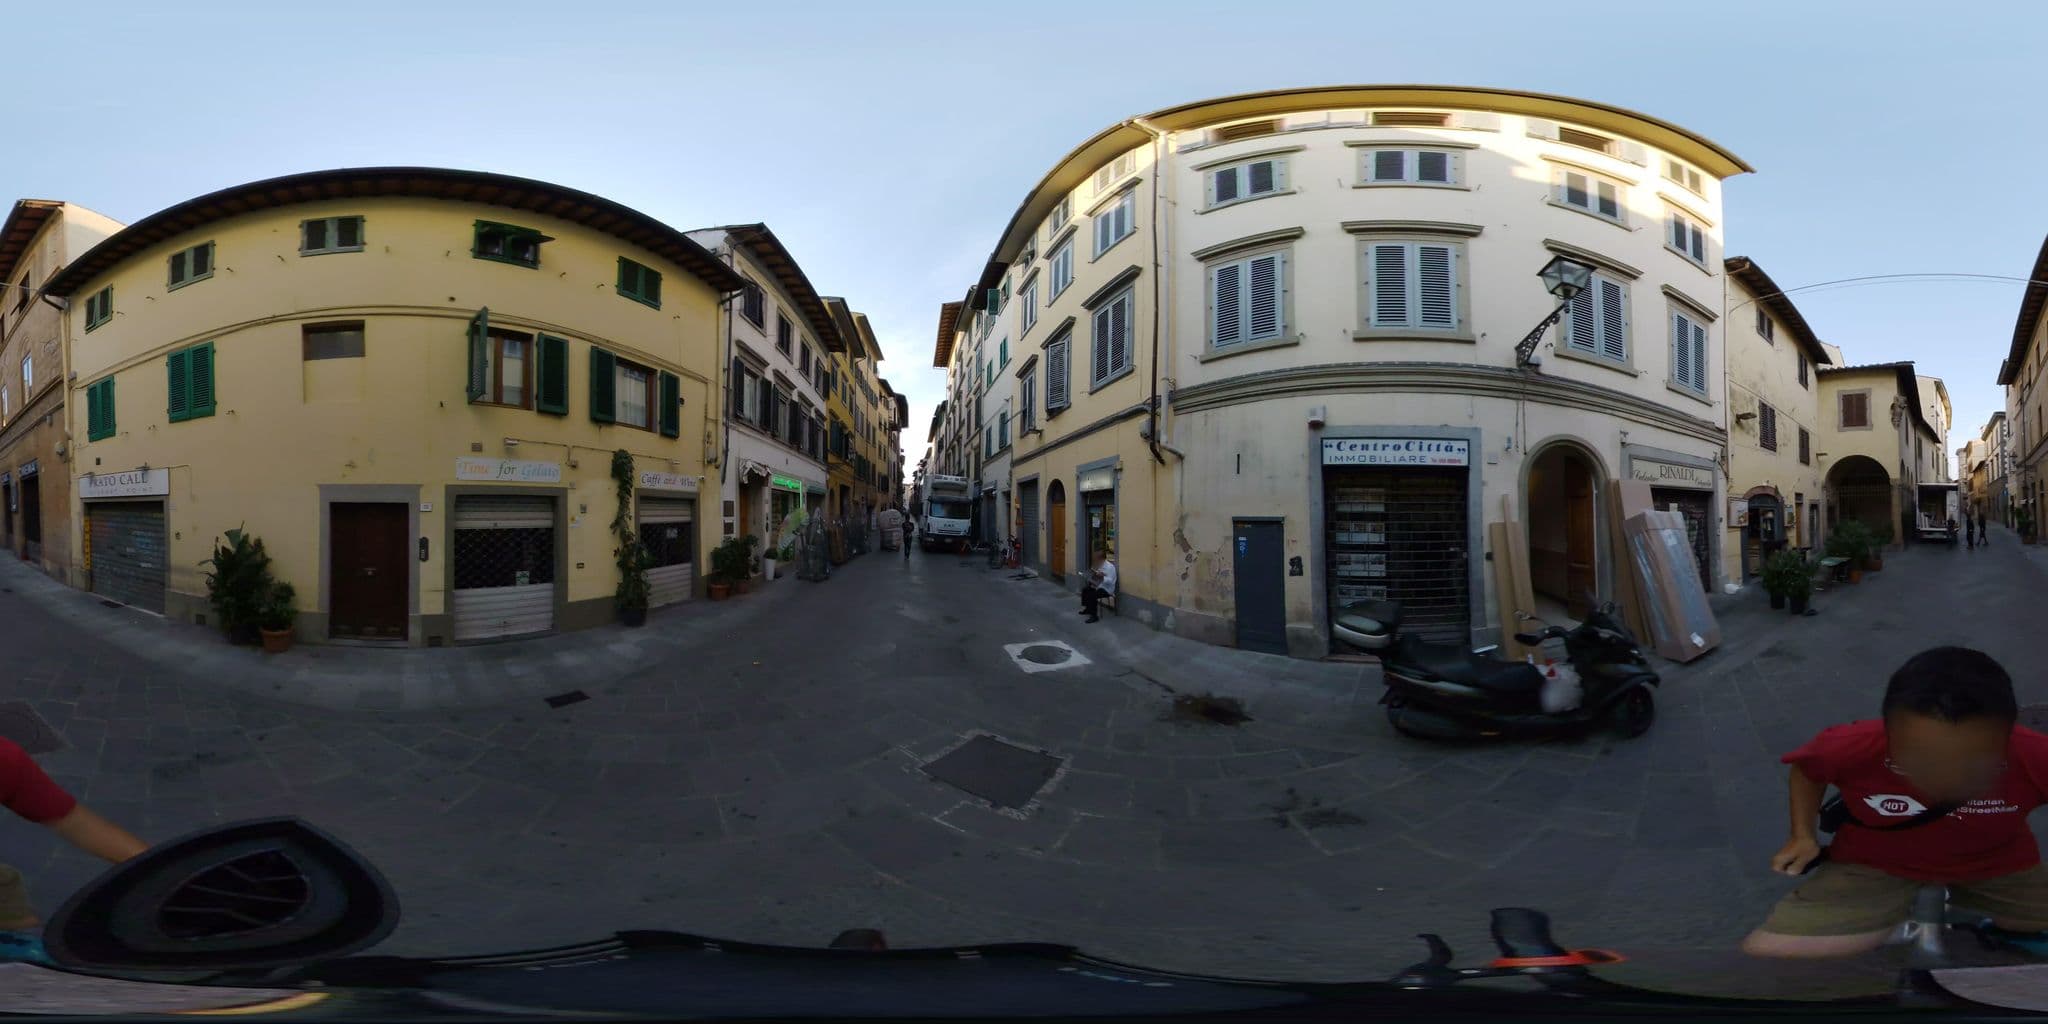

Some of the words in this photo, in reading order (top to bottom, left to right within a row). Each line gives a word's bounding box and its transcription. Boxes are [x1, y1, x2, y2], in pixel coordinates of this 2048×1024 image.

[1328, 455, 1427, 464] IMMOBILIARE
[496, 459, 517, 479] for
[1659, 464, 1695, 481] RINALDI
[119, 473, 148, 485] CALL
[1882, 802, 1906, 812] HOT
